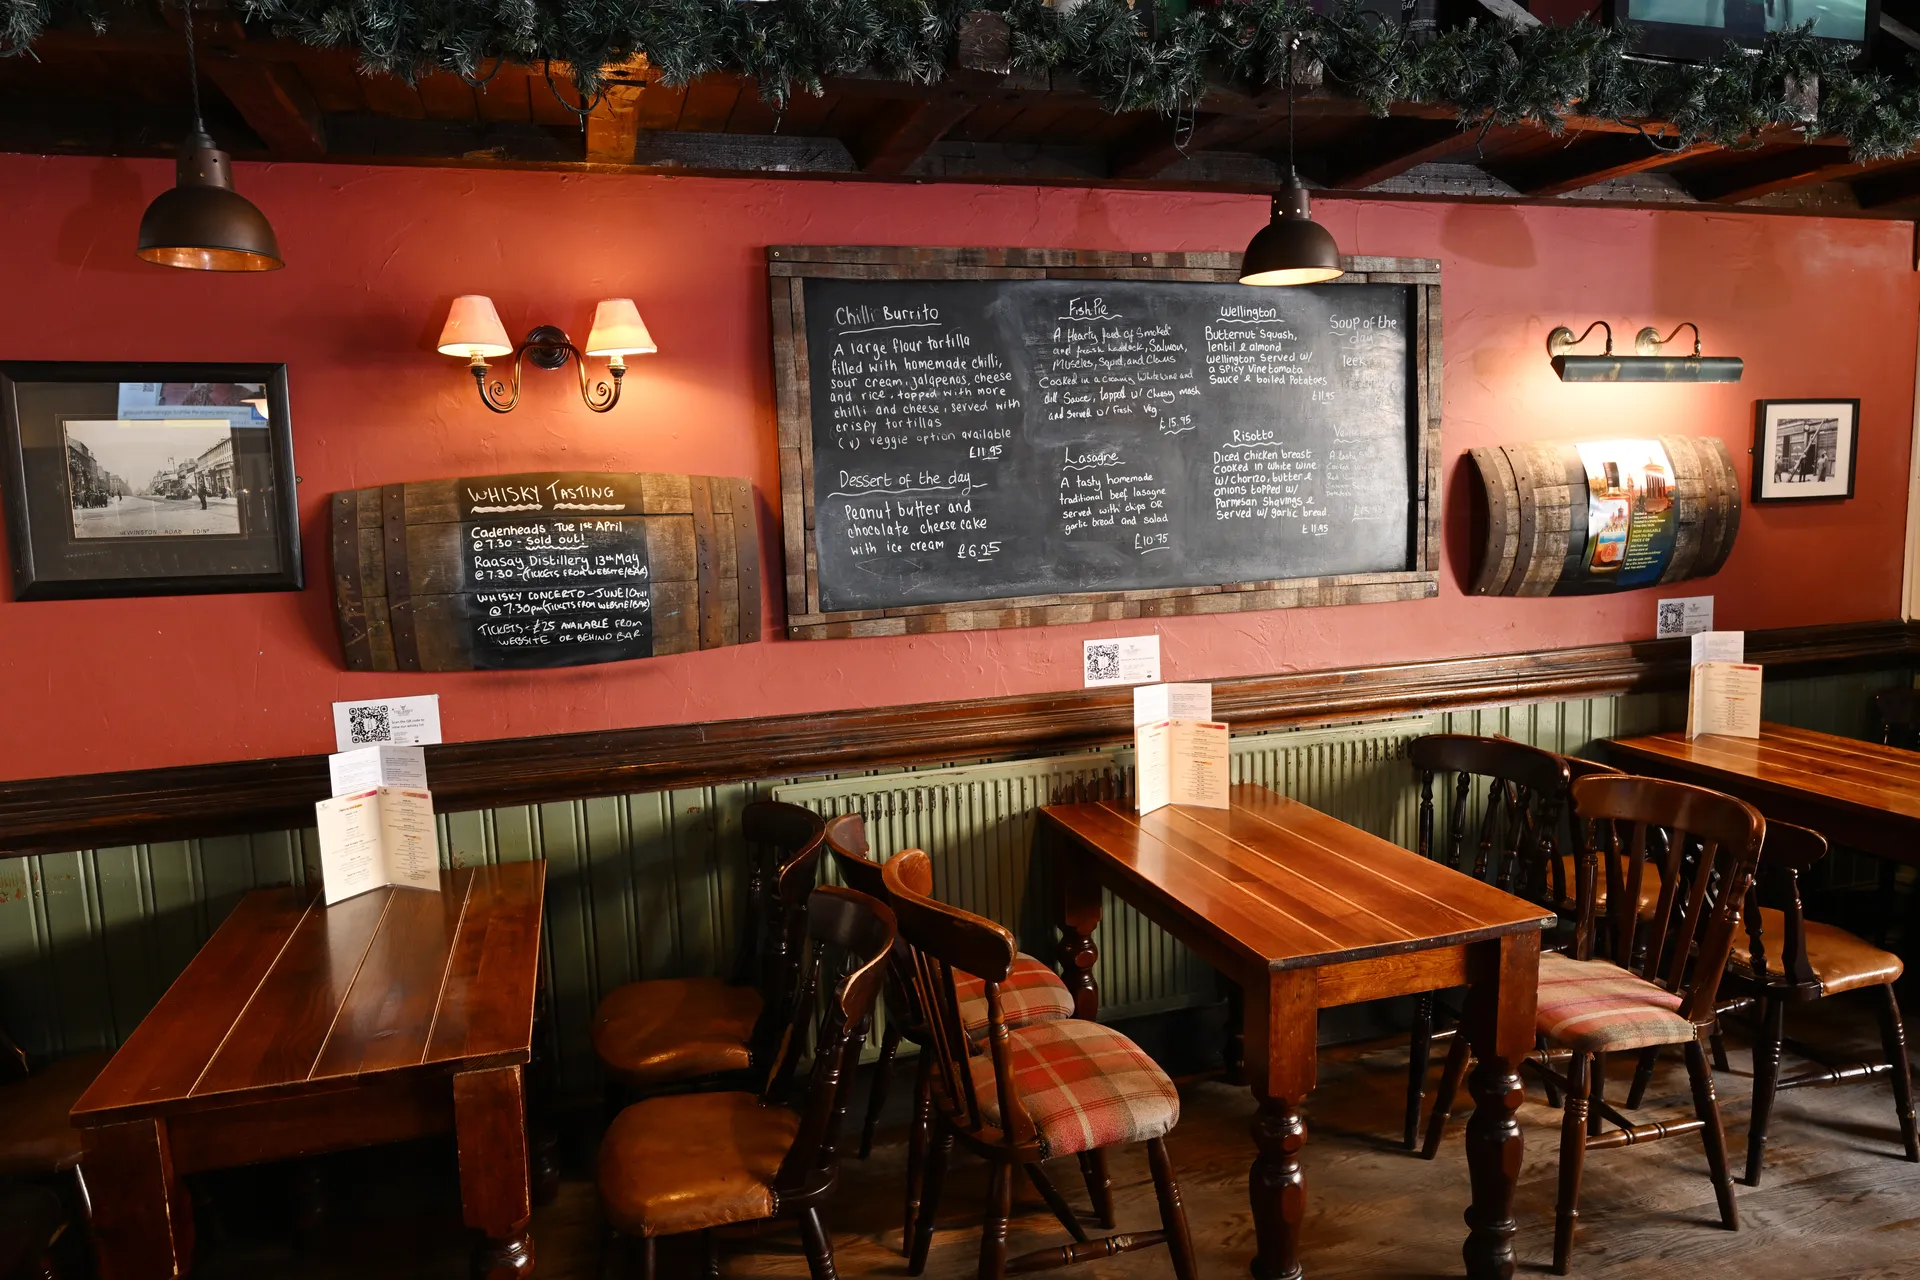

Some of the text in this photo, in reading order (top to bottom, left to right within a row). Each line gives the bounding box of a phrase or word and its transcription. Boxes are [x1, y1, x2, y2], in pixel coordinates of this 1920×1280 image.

[836, 304, 939, 325] Chilli Burrito
[1069, 298, 1108, 315] Fish Pie
[1221, 306, 1276, 320] Wellington
[1330, 314, 1397, 331] Soup of the
[1053, 328, 1060, 342] A
[1068, 327, 1098, 345] Hearty
[1124, 331, 1133, 342] of
[1206, 326, 1256, 340] Butternut
[834, 334, 970, 360] A large flour tortilla
[1208, 342, 1281, 352] lentil almond
[832, 353, 1002, 375] filled with homemade chilli,
[1127, 357, 1144, 365] and
[830, 379, 857, 388] sour
[974, 372, 1012, 383] cheese
[1039, 373, 1077, 388] Cooked
[1180, 369, 1193, 378] and
[1257, 375, 1285, 384] boiled
[830, 387, 1006, 402] and topped with more
[1045, 393, 1057, 404] dill
[1179, 386, 1200, 395] mash
[834, 399, 1020, 418] chilli and served with
[1049, 407, 1063, 420] and
[836, 415, 942, 433] crispy tortillas
[870, 429, 1012, 449] veggie option available
[1233, 430, 1273, 442] Risotto
[969, 445, 1002, 458] £11.95
[1065, 447, 1119, 465] Lasagne
[1214, 452, 1239, 464] Diced
[1281, 449, 1312, 458] breast
[840, 470, 972, 496] Dessert of the day
[1061, 473, 1153, 491] A tasty homemade
[1272, 472, 1302, 482] butter
[468, 480, 614, 502] WHISKY TASTING
[1059, 488, 1166, 505] traditional beef lasagne
[1214, 486, 1246, 496] onions
[845, 500, 972, 520] Peanut butter and
[1063, 501, 1163, 518] served with chips OR
[1271, 508, 1298, 518] garlic
[472, 521, 622, 538] Cadenheads Tue 1st April
[848, 521, 909, 538] chocolate
[1065, 514, 1168, 535] garlic bread and salad
[474, 536, 585, 551] @ 7.30 Sold out!
[851, 540, 944, 555] with ice cream
[1135, 533, 1168, 549] £10.75
[958, 542, 1002, 558] £6.25
[475, 554, 640, 570] Raasay Distillery 13th May
[475, 570, 484, 580] @
[487, 569, 513, 580] 7.30
[477, 592, 522, 602] WHISKY
[528, 590, 585, 599] CONCERTO
[489, 607, 501, 616] @
[578, 600, 596, 608] FROM
[561, 618, 609, 629] AVAILABLE
[615, 619, 642, 628] FROM
[498, 635, 550, 645] WEBSITE
[559, 634, 573, 643] OR
[577, 632, 612, 642] BEHIND
